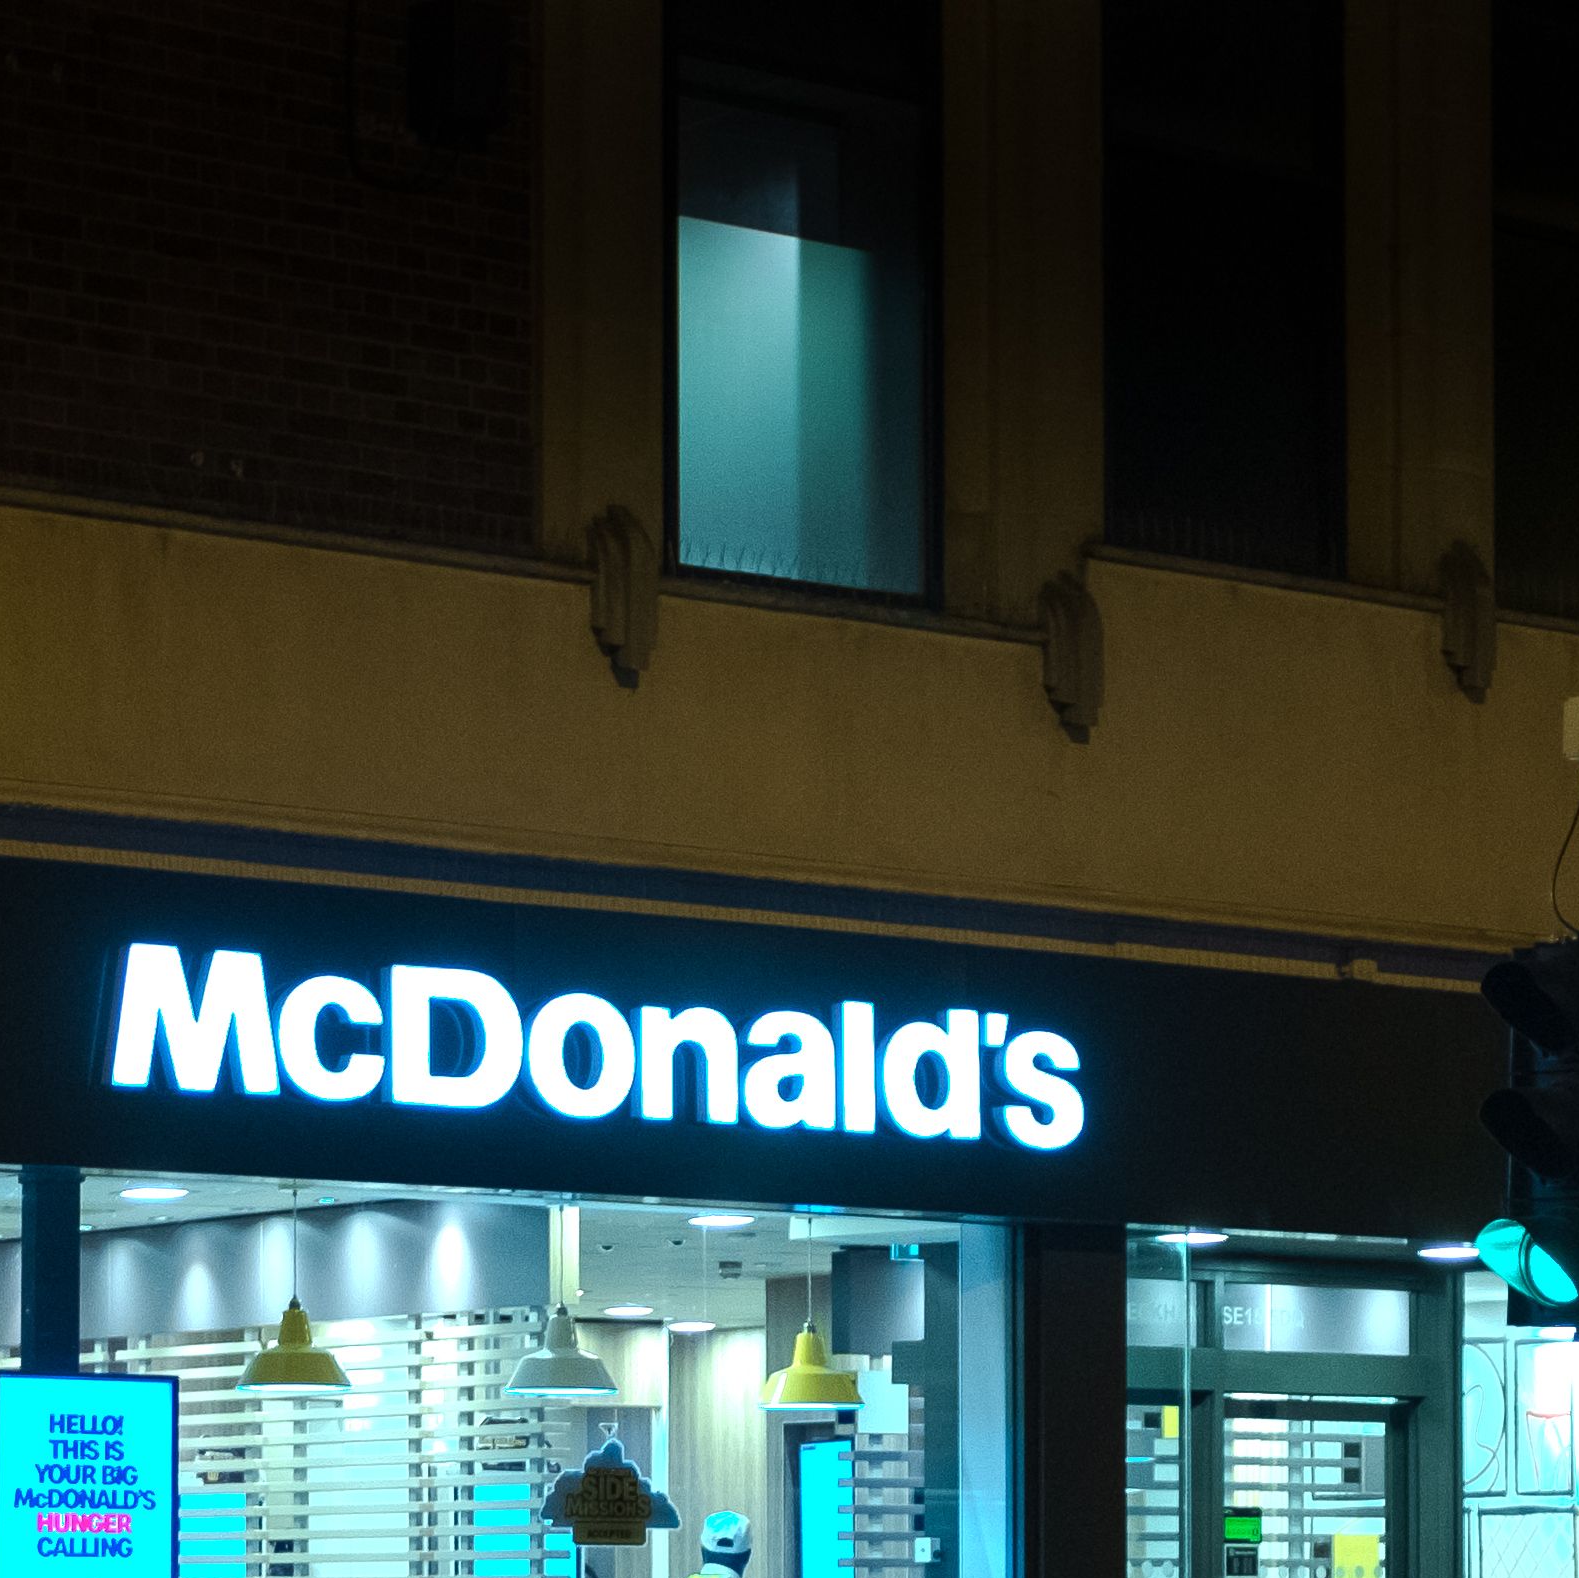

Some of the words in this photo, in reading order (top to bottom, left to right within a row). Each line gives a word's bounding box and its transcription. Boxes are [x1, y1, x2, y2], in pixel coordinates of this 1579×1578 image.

[111, 941, 1084, 1151] McDonald's
[49, 1414, 124, 1435] HELLO!
[49, 1439, 99, 1460] THIS
[104, 1440, 125, 1461] IS
[35, 1464, 97, 1485] YOUR
[102, 1465, 139, 1485] BIG
[583, 1474, 639, 1500] SIDE
[14, 1488, 156, 1510] McDONALD'S
[36, 1512, 132, 1534] HUNGER
[37, 1536, 133, 1558] CALLING
